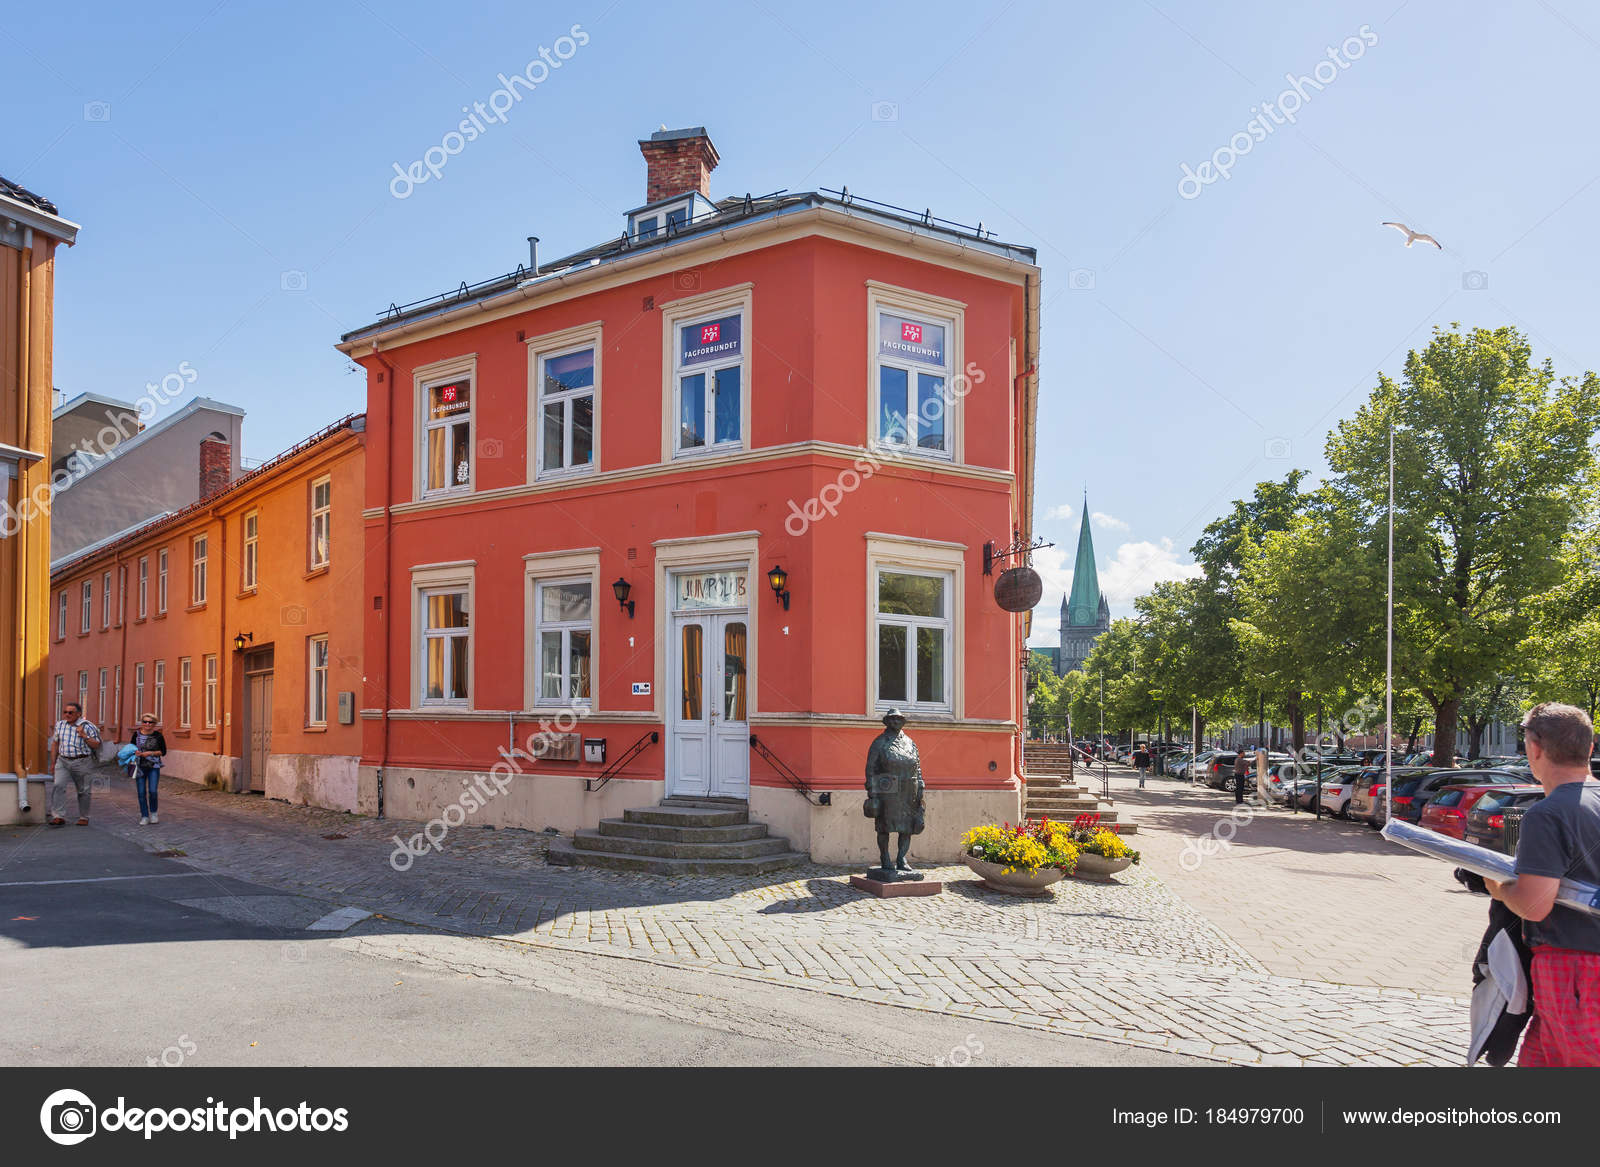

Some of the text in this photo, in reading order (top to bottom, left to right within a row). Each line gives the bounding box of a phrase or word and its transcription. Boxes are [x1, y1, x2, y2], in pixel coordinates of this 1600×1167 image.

[684, 341, 737, 358] FAGFORBUNDET
[883, 340, 941, 358] FAGFORBUNDET
[628, 636, 635, 648] 1
